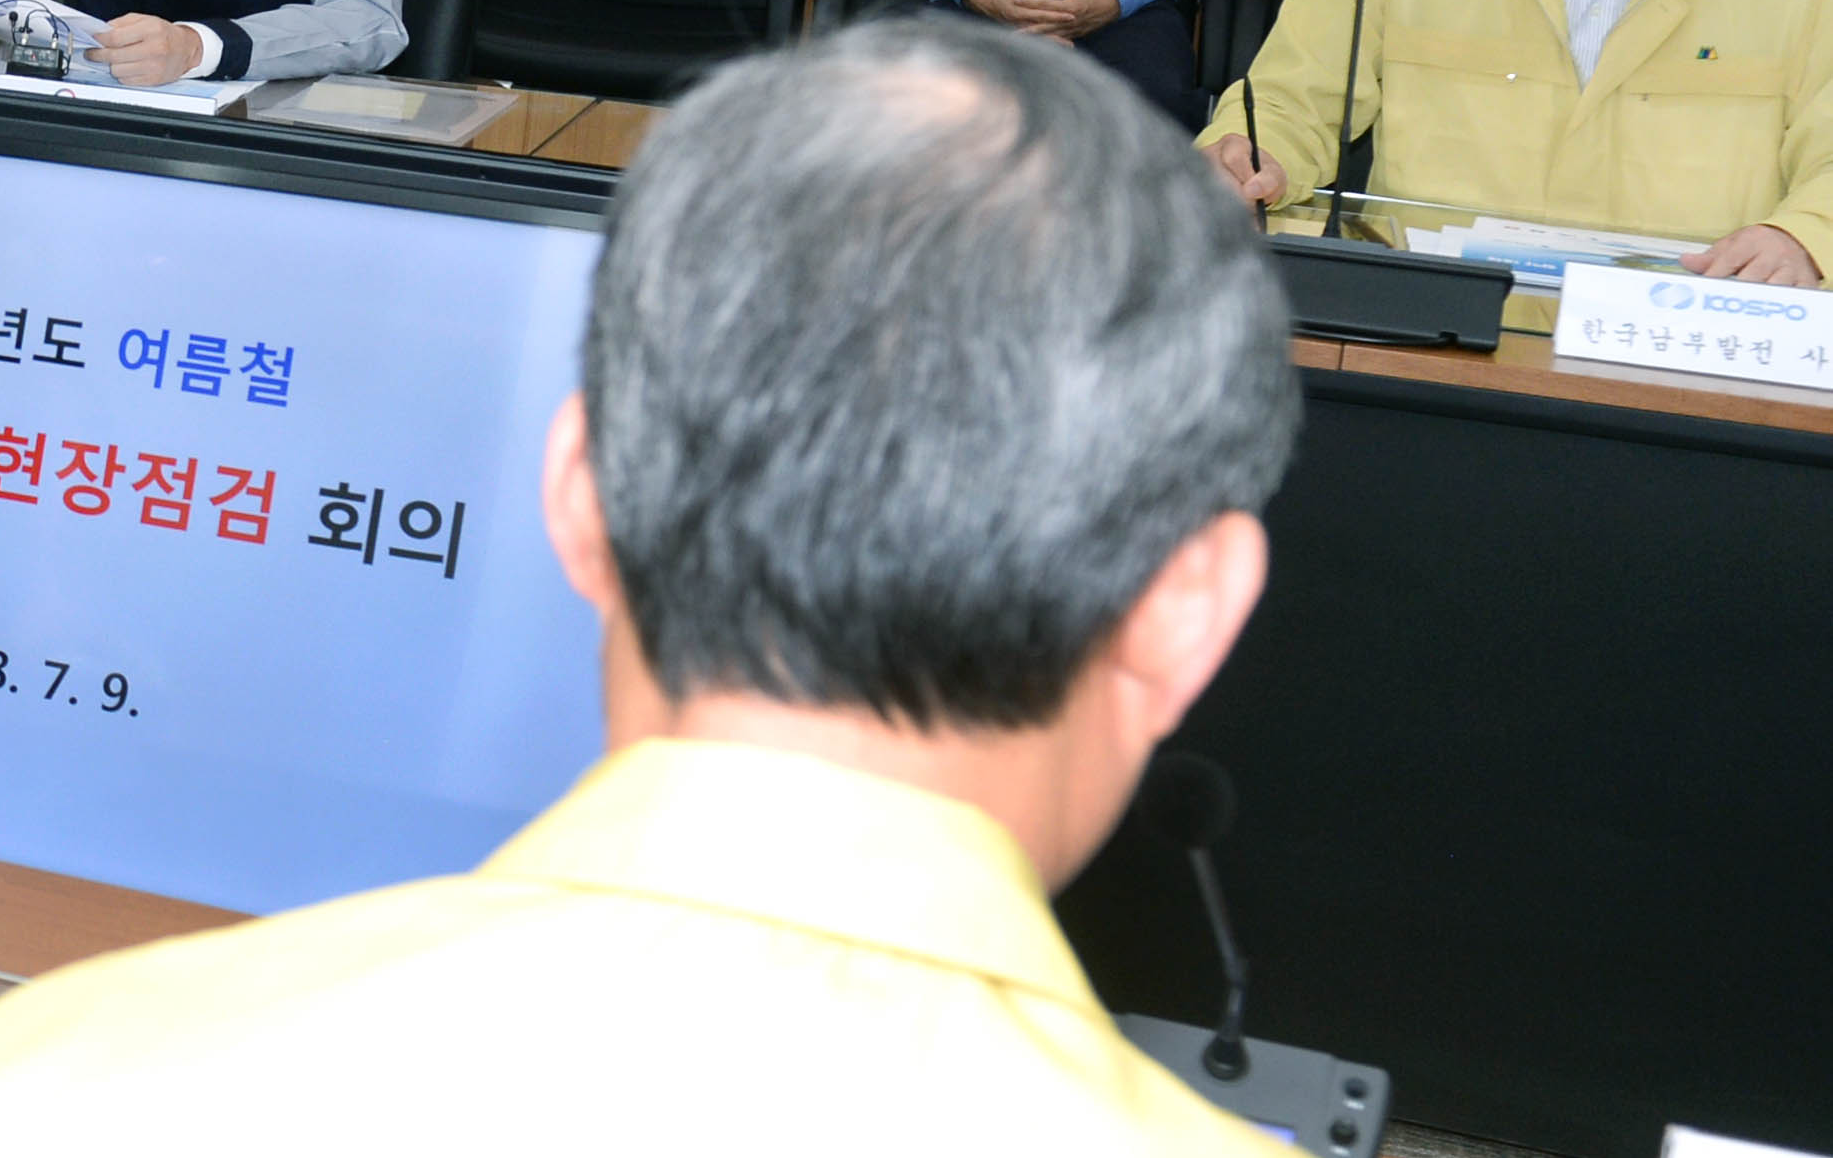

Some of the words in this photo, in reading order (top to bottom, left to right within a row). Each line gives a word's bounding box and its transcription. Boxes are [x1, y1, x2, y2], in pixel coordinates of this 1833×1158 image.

[117, 326, 297, 410] 여름철
[1582, 318, 1774, 365] 한국남부발전
[306, 480, 468, 581] 회의
[42, 659, 79, 707] 7.
[100, 672, 140, 719] 9.
